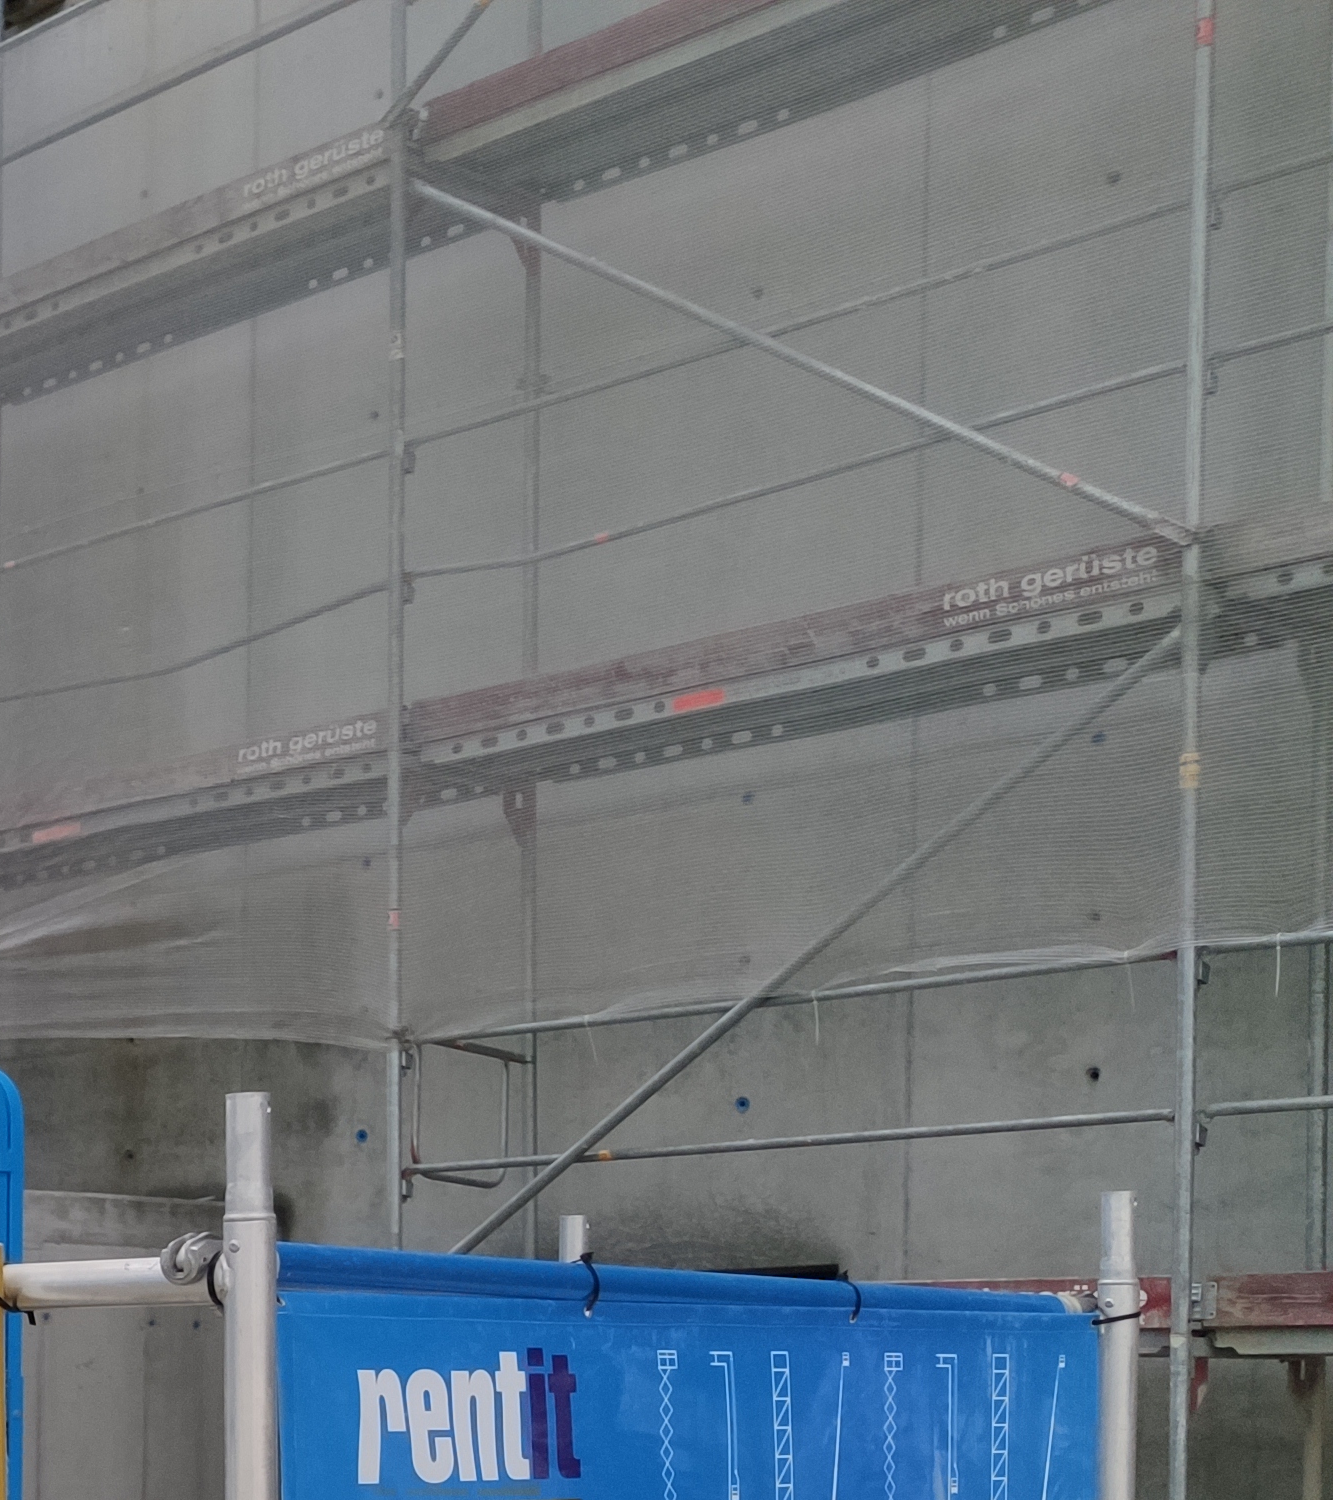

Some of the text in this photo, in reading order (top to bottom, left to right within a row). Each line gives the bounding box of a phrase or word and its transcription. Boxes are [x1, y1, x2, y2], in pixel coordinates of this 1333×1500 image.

[243, 167, 287, 198] roth
[294, 129, 384, 180] gerüste
[943, 546, 1158, 611] roth gerüste
[943, 608, 990, 627] wenn
[995, 589, 1076, 616] Schönes
[237, 719, 377, 762] roth gerüste
[357, 1347, 582, 1484] rentit
